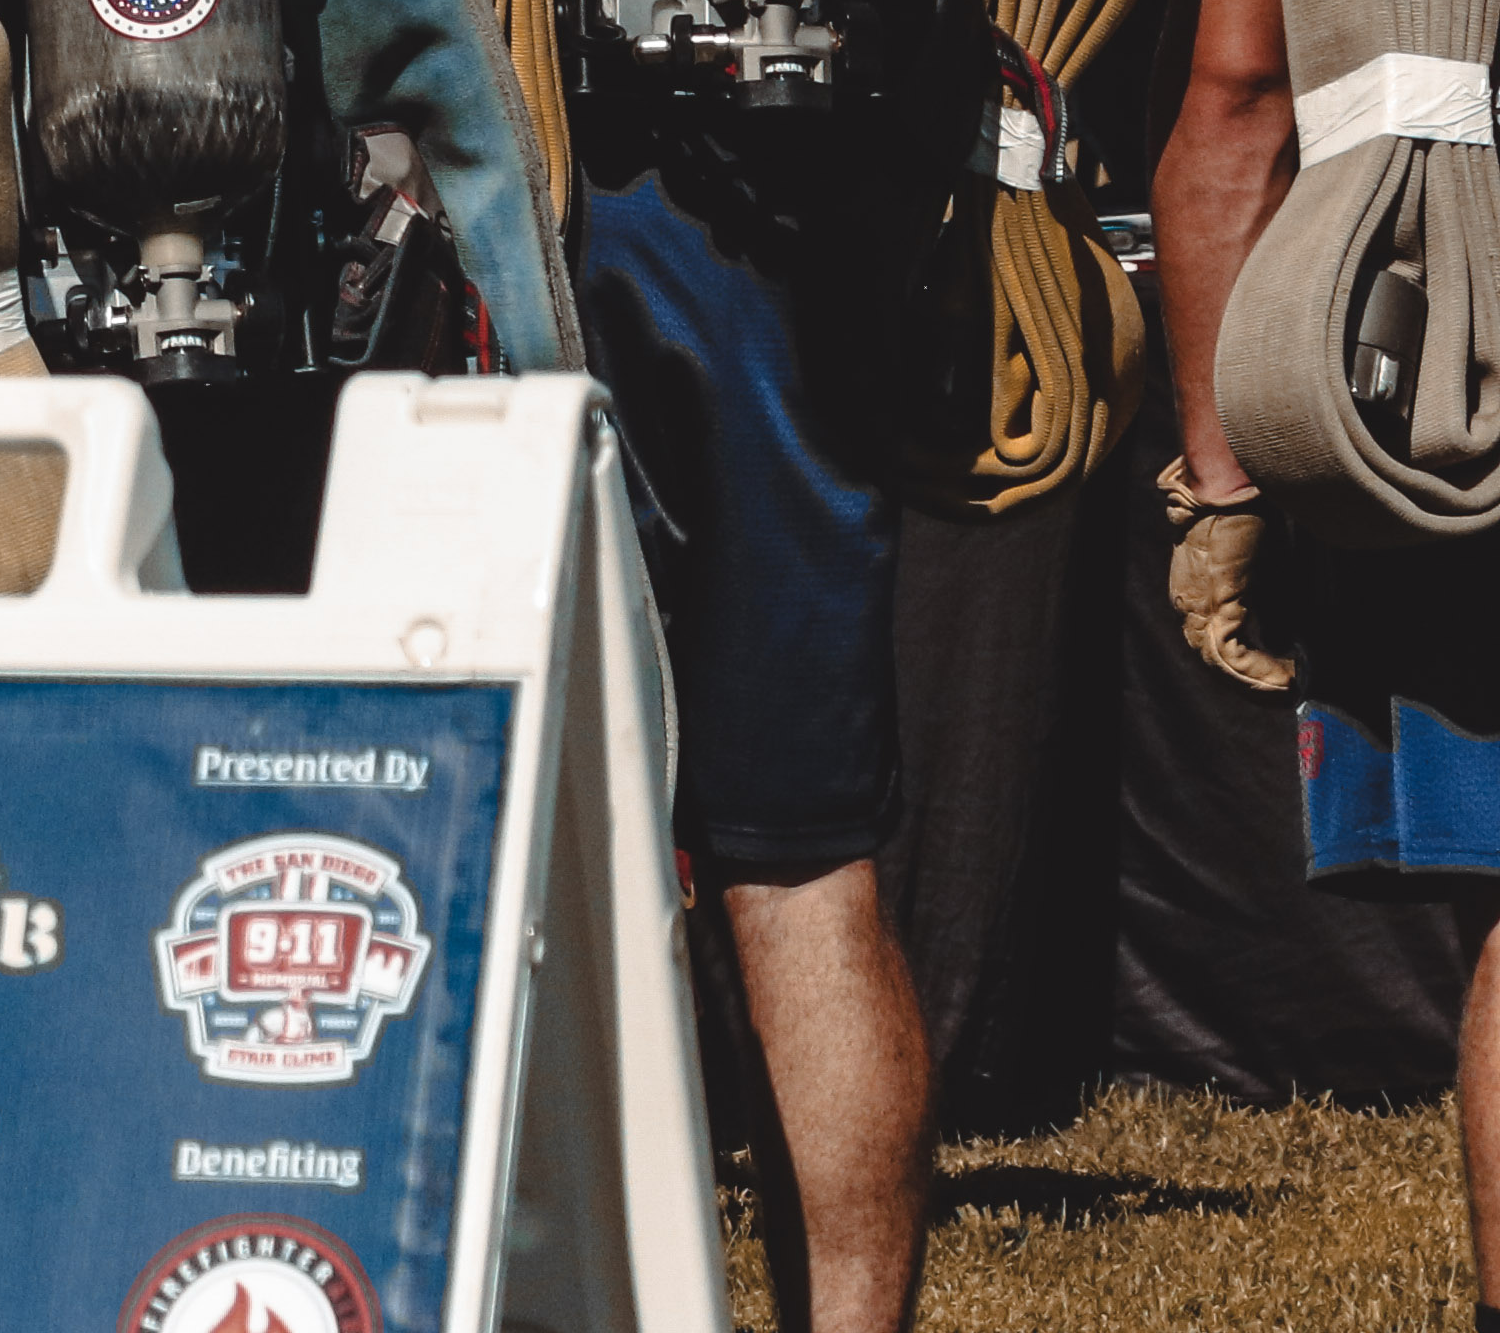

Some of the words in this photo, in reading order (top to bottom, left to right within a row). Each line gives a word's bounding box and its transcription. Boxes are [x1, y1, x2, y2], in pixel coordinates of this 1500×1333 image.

[197, 745, 376, 785] Presented
[384, 754, 429, 791] By
[177, 1142, 362, 1187] Benefiting
